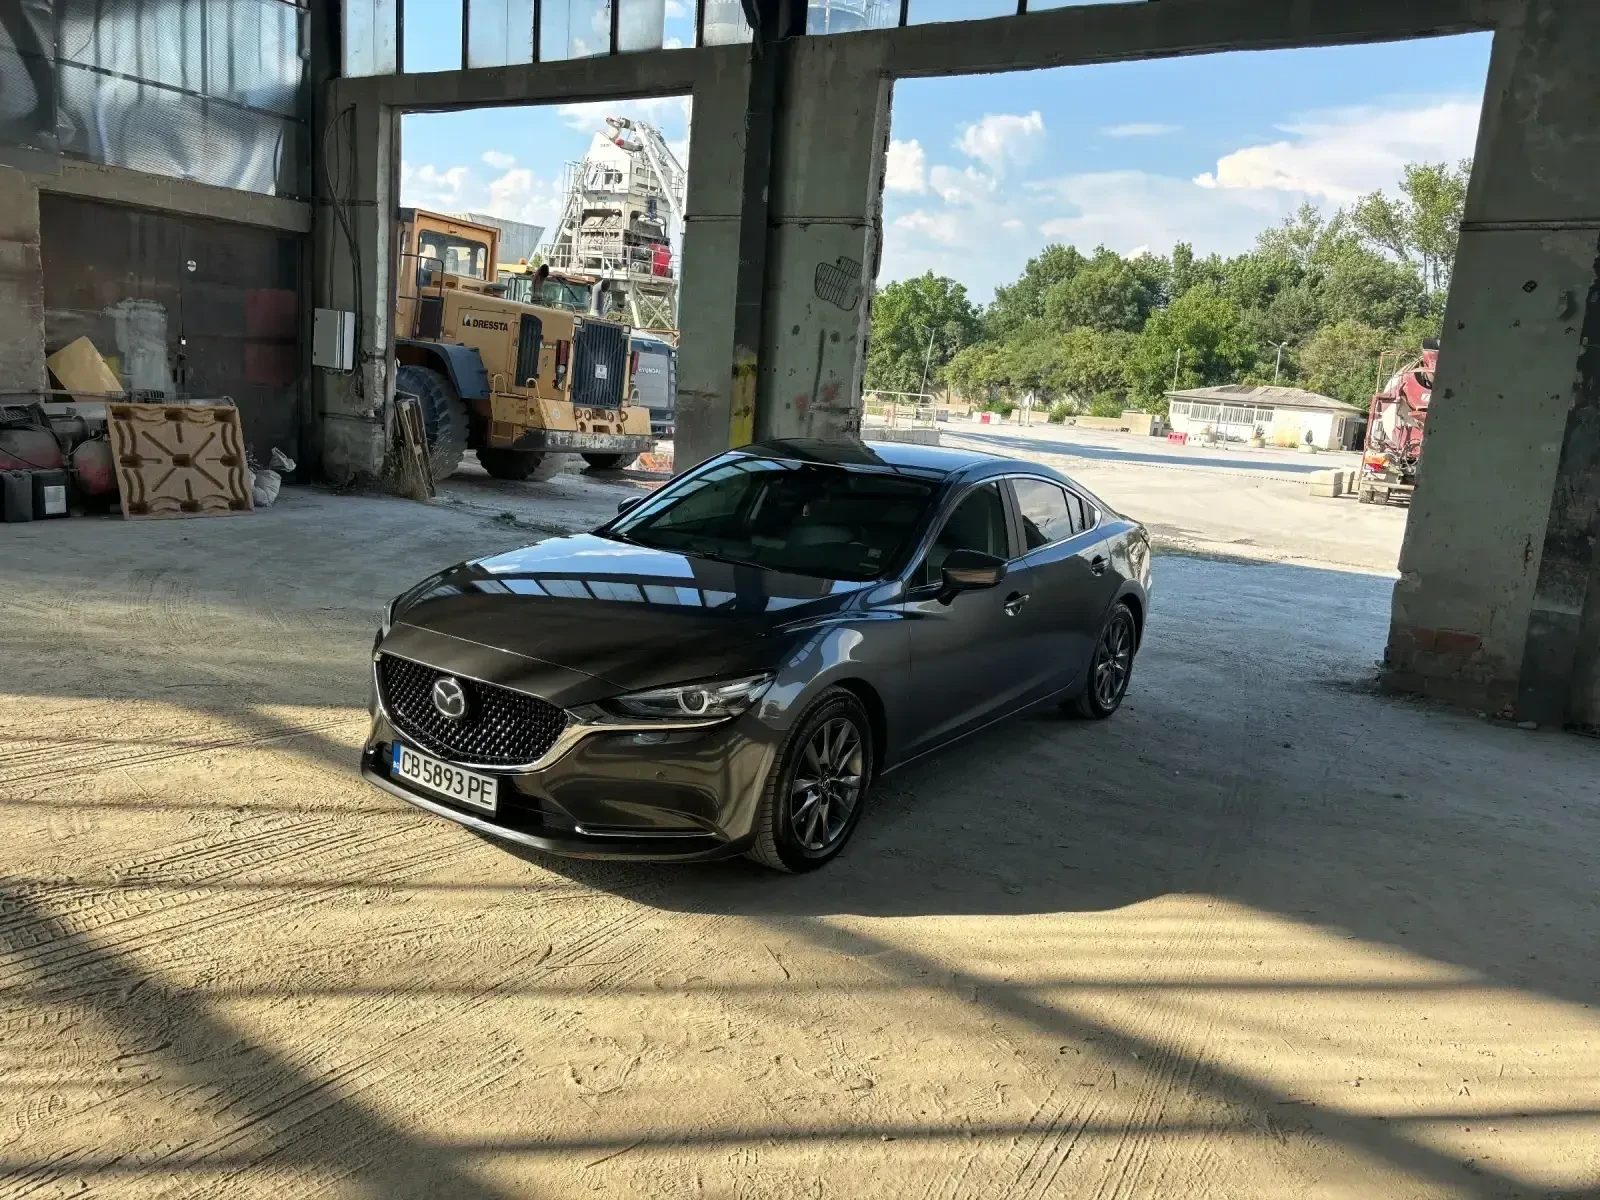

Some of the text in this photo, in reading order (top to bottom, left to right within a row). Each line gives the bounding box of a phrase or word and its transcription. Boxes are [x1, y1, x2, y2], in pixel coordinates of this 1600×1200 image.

[473, 319, 508, 331] DRESSTA
[402, 751, 493, 805] CB 5893 PE
